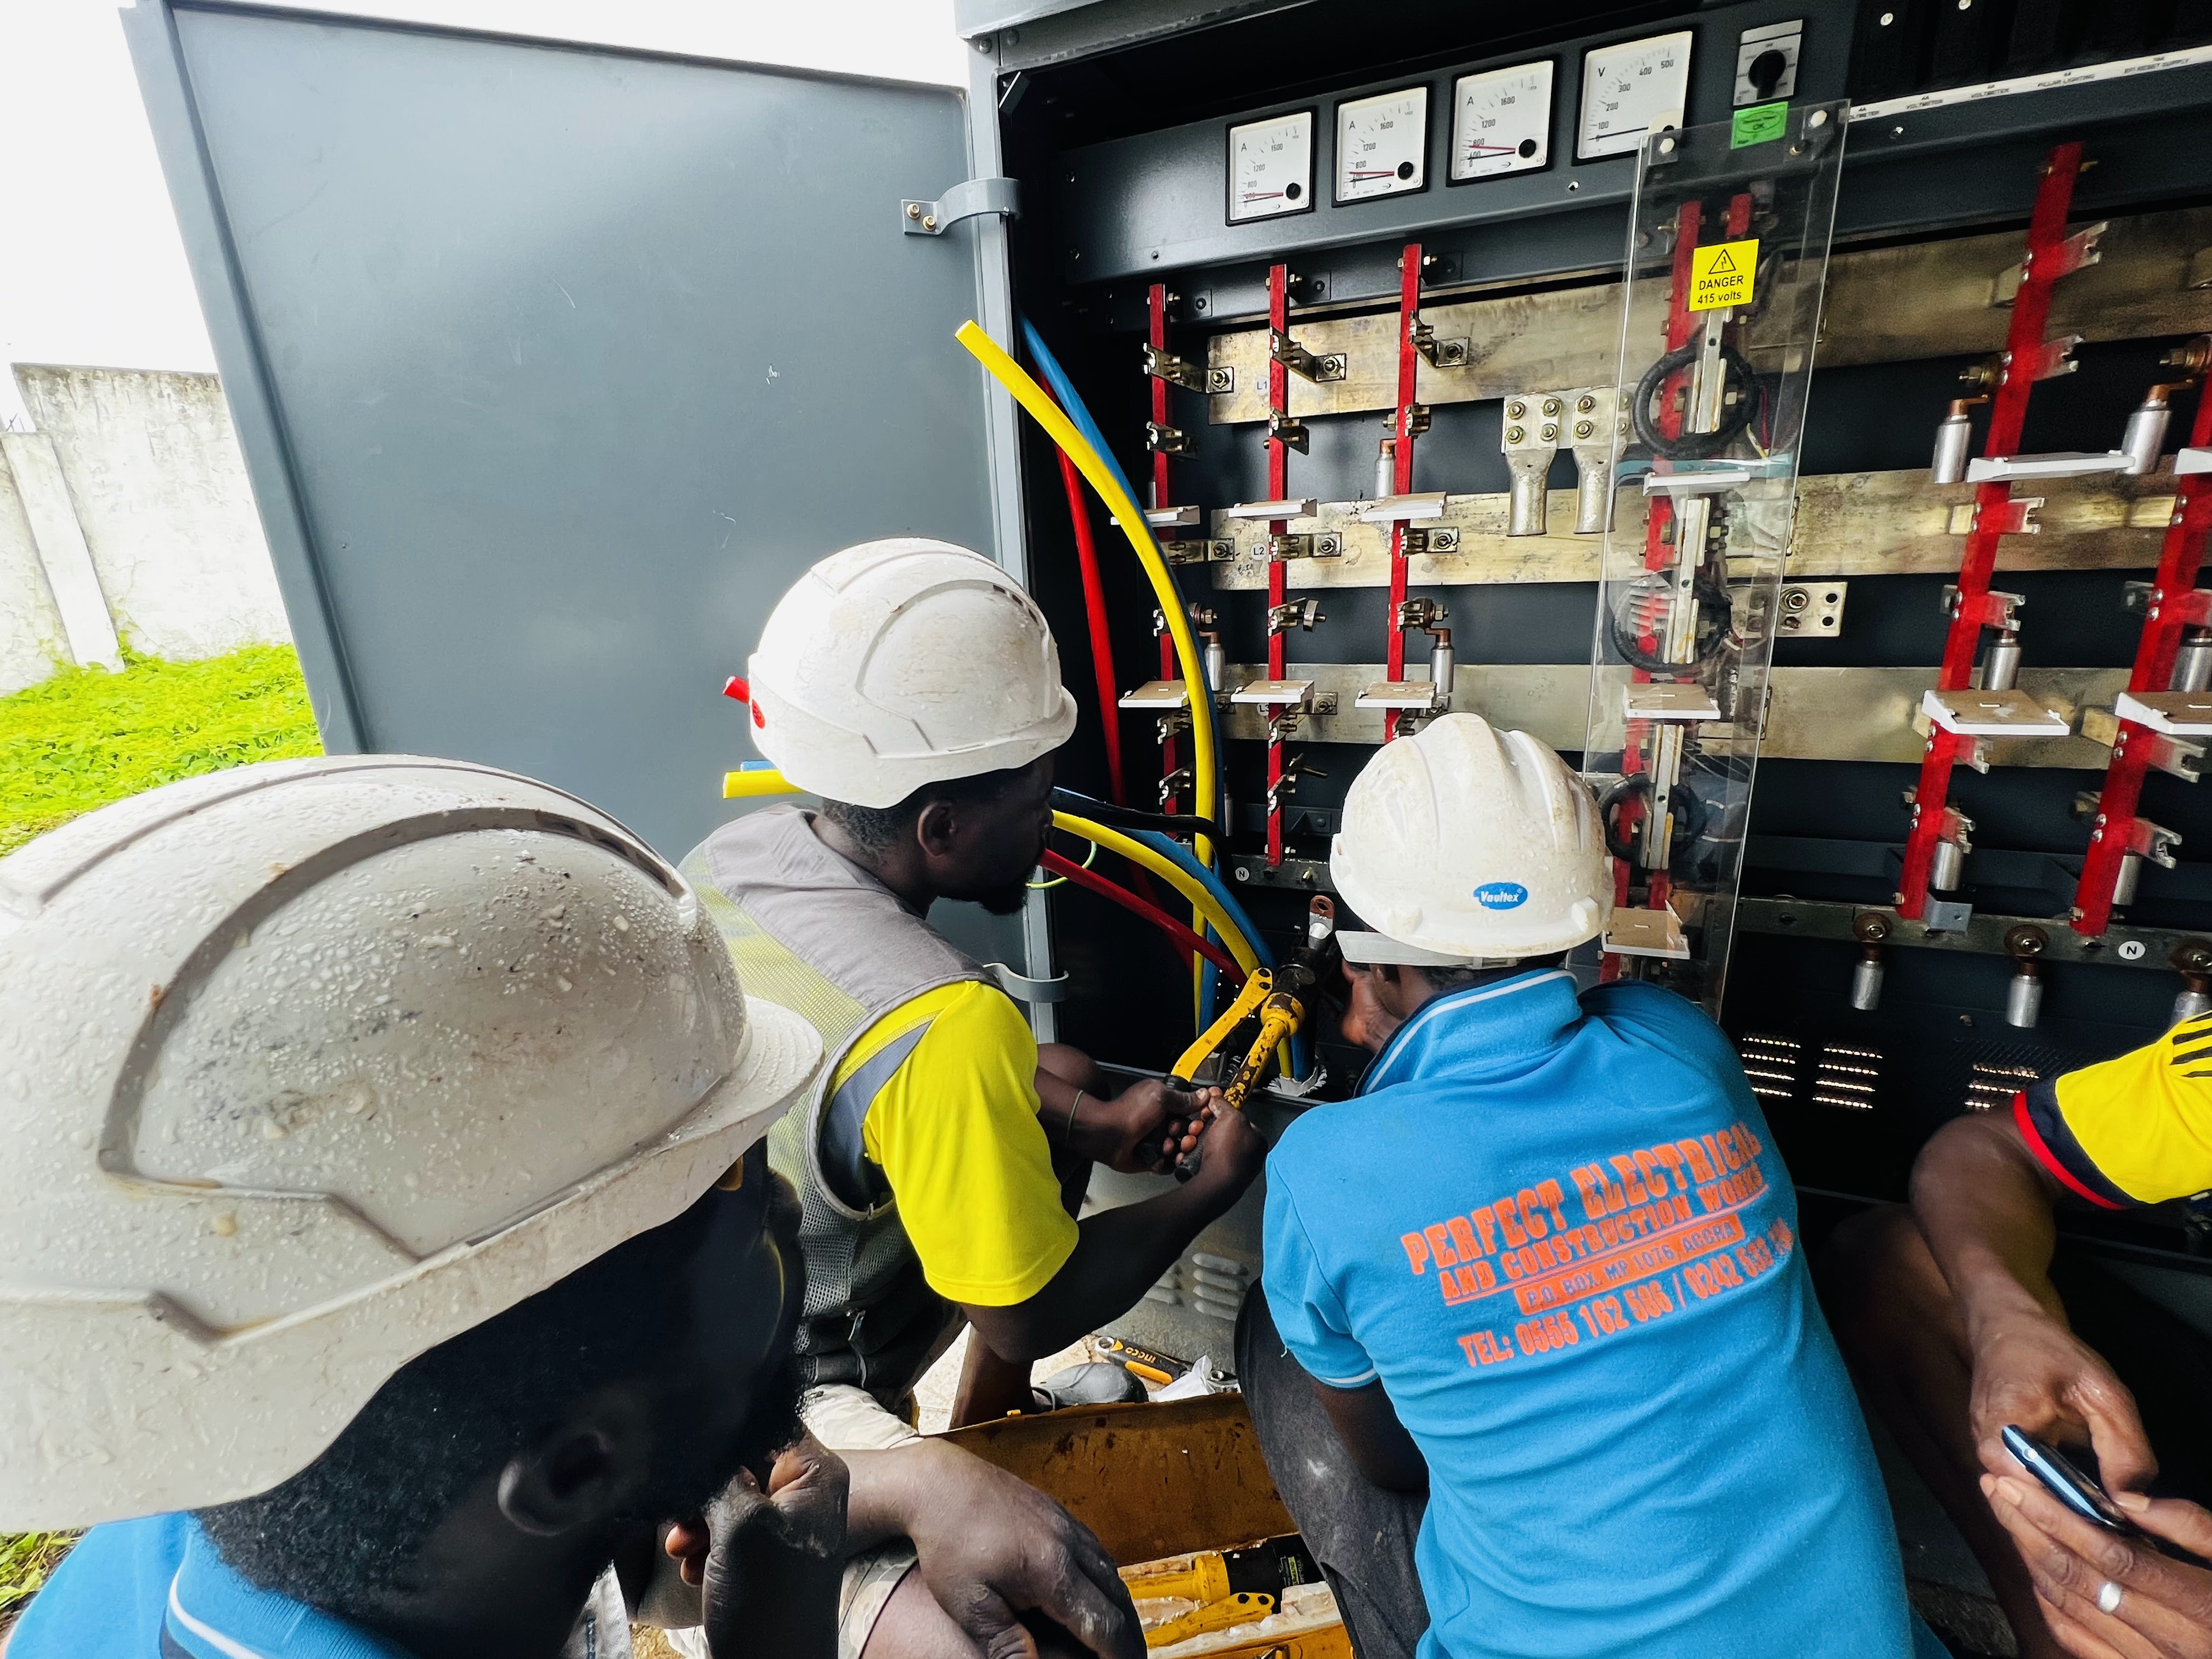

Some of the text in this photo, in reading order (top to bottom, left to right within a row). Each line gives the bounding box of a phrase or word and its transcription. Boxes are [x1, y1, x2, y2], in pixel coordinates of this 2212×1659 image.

[1661, 59, 1674, 69] 500
[1598, 67, 1605, 77] V
[1639, 67, 1652, 76] 400
[1618, 83, 1630, 92] 300
[1467, 96, 1474, 106] A
[1501, 96, 1515, 106] 1600
[1606, 102, 1618, 111] 200
[1348, 121, 1356, 130] A
[1380, 121, 1393, 130] 1600
[1482, 119, 1496, 128] 1200
[1598, 121, 1609, 129] 100
[1241, 143, 1247, 152] A
[1271, 143, 1283, 152] 1600
[1363, 143, 1376, 151] 1200
[1254, 164, 1265, 172] 1200
[1699, 275, 1744, 290] DANGER
[1697, 290, 1742, 304] 415 volts
[1257, 380, 1267, 390] L1
[1254, 546, 1265, 555] L2
[1480, 890, 1519, 902] Vaultex
[2126, 946, 2137, 955] N
[1401, 1121, 1762, 1274] PERFECT ELECTRICAL
[1439, 1162, 1763, 1299] AND CONSTRUCTION WORKS
[1604, 1260, 1629, 1282] MP
[1682, 1221, 1735, 1254] ACCRA
[1457, 1330, 1515, 1367] TEL:
[1515, 1311, 1579, 1356] 0555
[1578, 1292, 1629, 1338] 162
[1683, 1254, 1743, 1299] 0242
